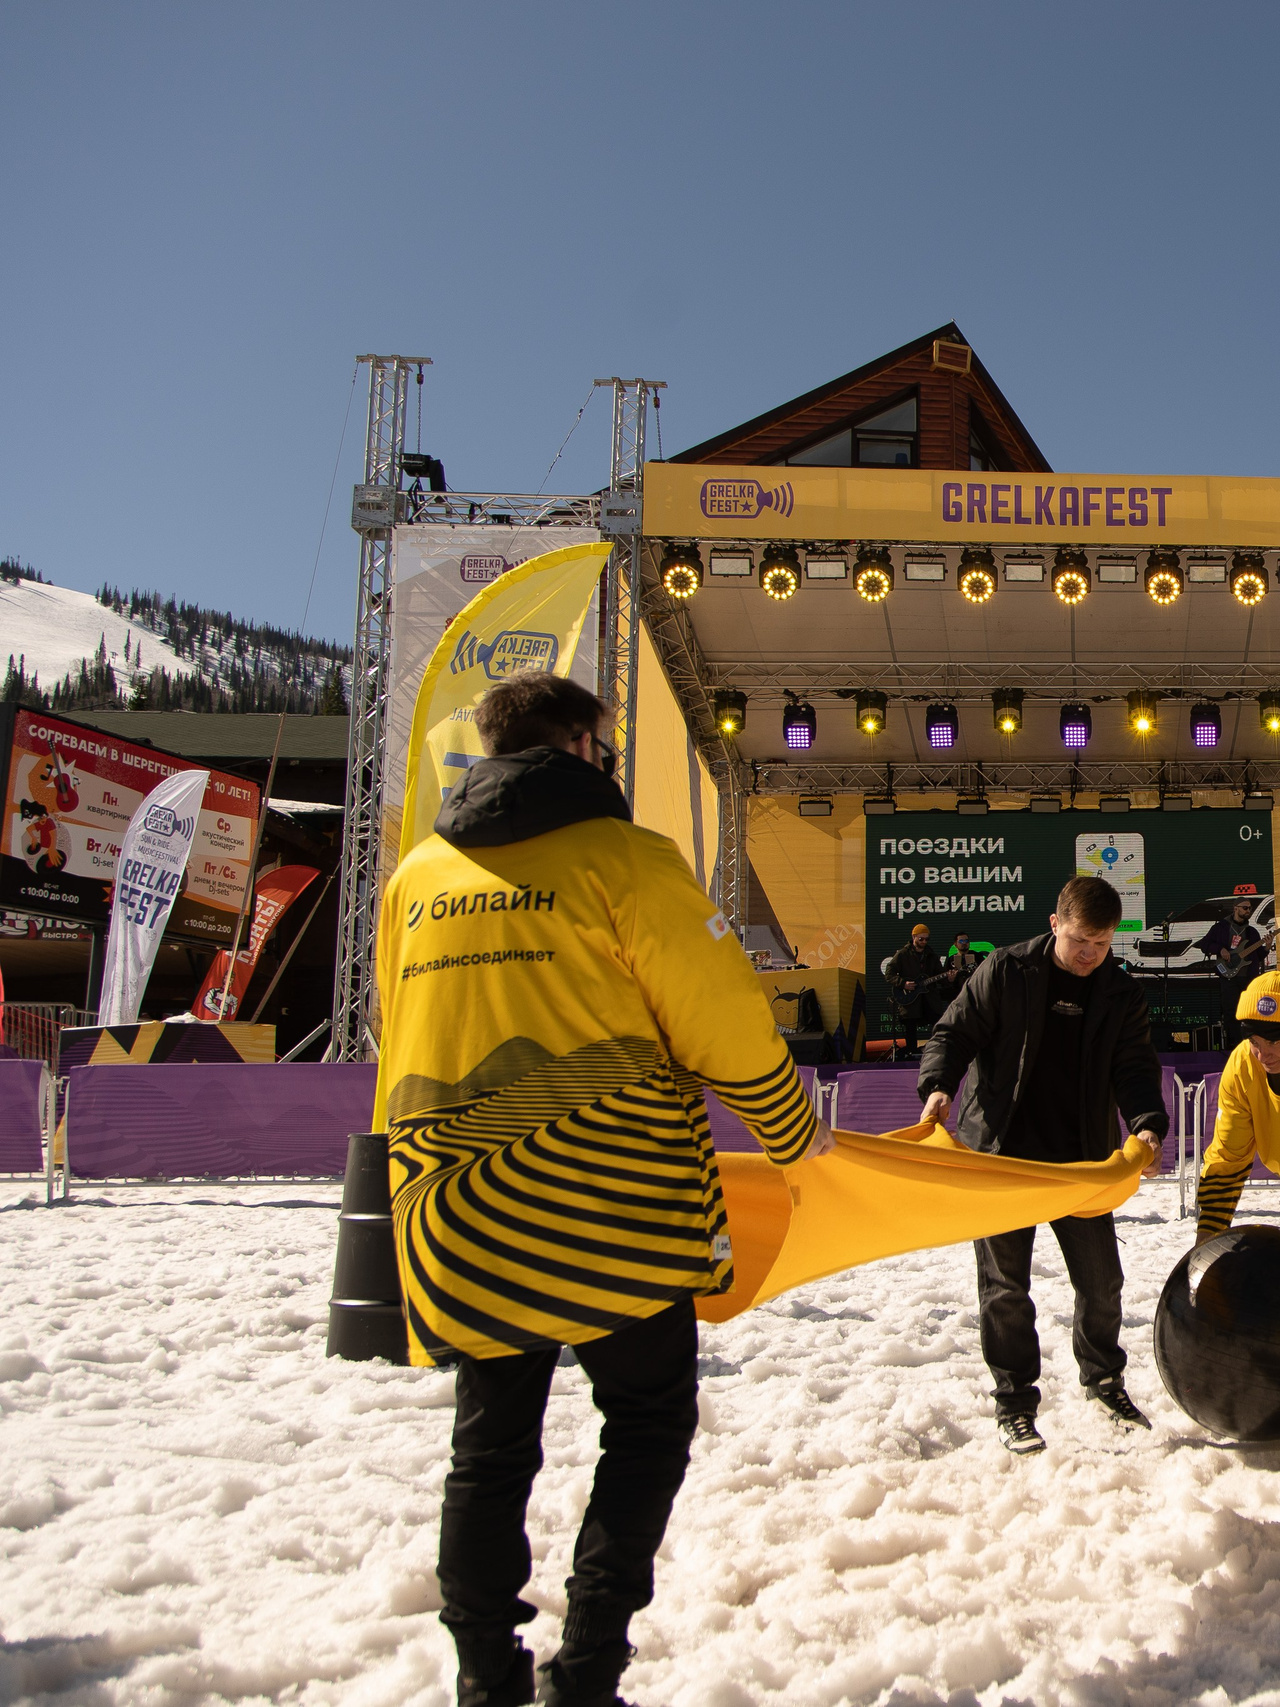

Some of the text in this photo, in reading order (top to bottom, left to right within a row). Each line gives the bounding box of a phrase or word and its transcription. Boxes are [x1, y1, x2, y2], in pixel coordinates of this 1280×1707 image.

[709, 484, 754, 498] GRELKA
[709, 499, 740, 513] FEST
[942, 482, 1173, 527] GRELKAFEST
[467, 558, 501, 569] GRELKA
[467, 569, 490, 579] FEST
[28, 724, 183, 778] СОГРЕВАЕМ В ШЕРЕГЕШ
[102, 791, 120, 807] Пн.
[214, 781, 225, 794] 10
[228, 787, 251, 801] ЛЕТ!
[87, 804, 131, 822] квартирник
[216, 817, 233, 834] Ср.
[1239, 825, 1264, 841] 0+
[202, 829, 245, 846] акустический
[210, 840, 236, 852] концерт
[880, 837, 1005, 858] поездки
[92, 856, 114, 869] Dj-set
[203, 861, 238, 881] Пт./Сб.
[880, 865, 1023, 885] по вашим
[194, 875, 213, 886] днем
[218, 881, 245, 893] вечером
[208, 885, 230, 897] Dj-sets
[28, 886, 49, 898] 10:00
[50, 892, 60, 901] до
[61, 893, 79, 904] 0:00
[431, 883, 556, 920] билайн
[879, 894, 1025, 919] правилам
[190, 918, 207, 929] 10:00
[207, 923, 217, 931] до
[216, 923, 232, 934] 2:00
[401, 948, 556, 982] #билайнсоединяет
